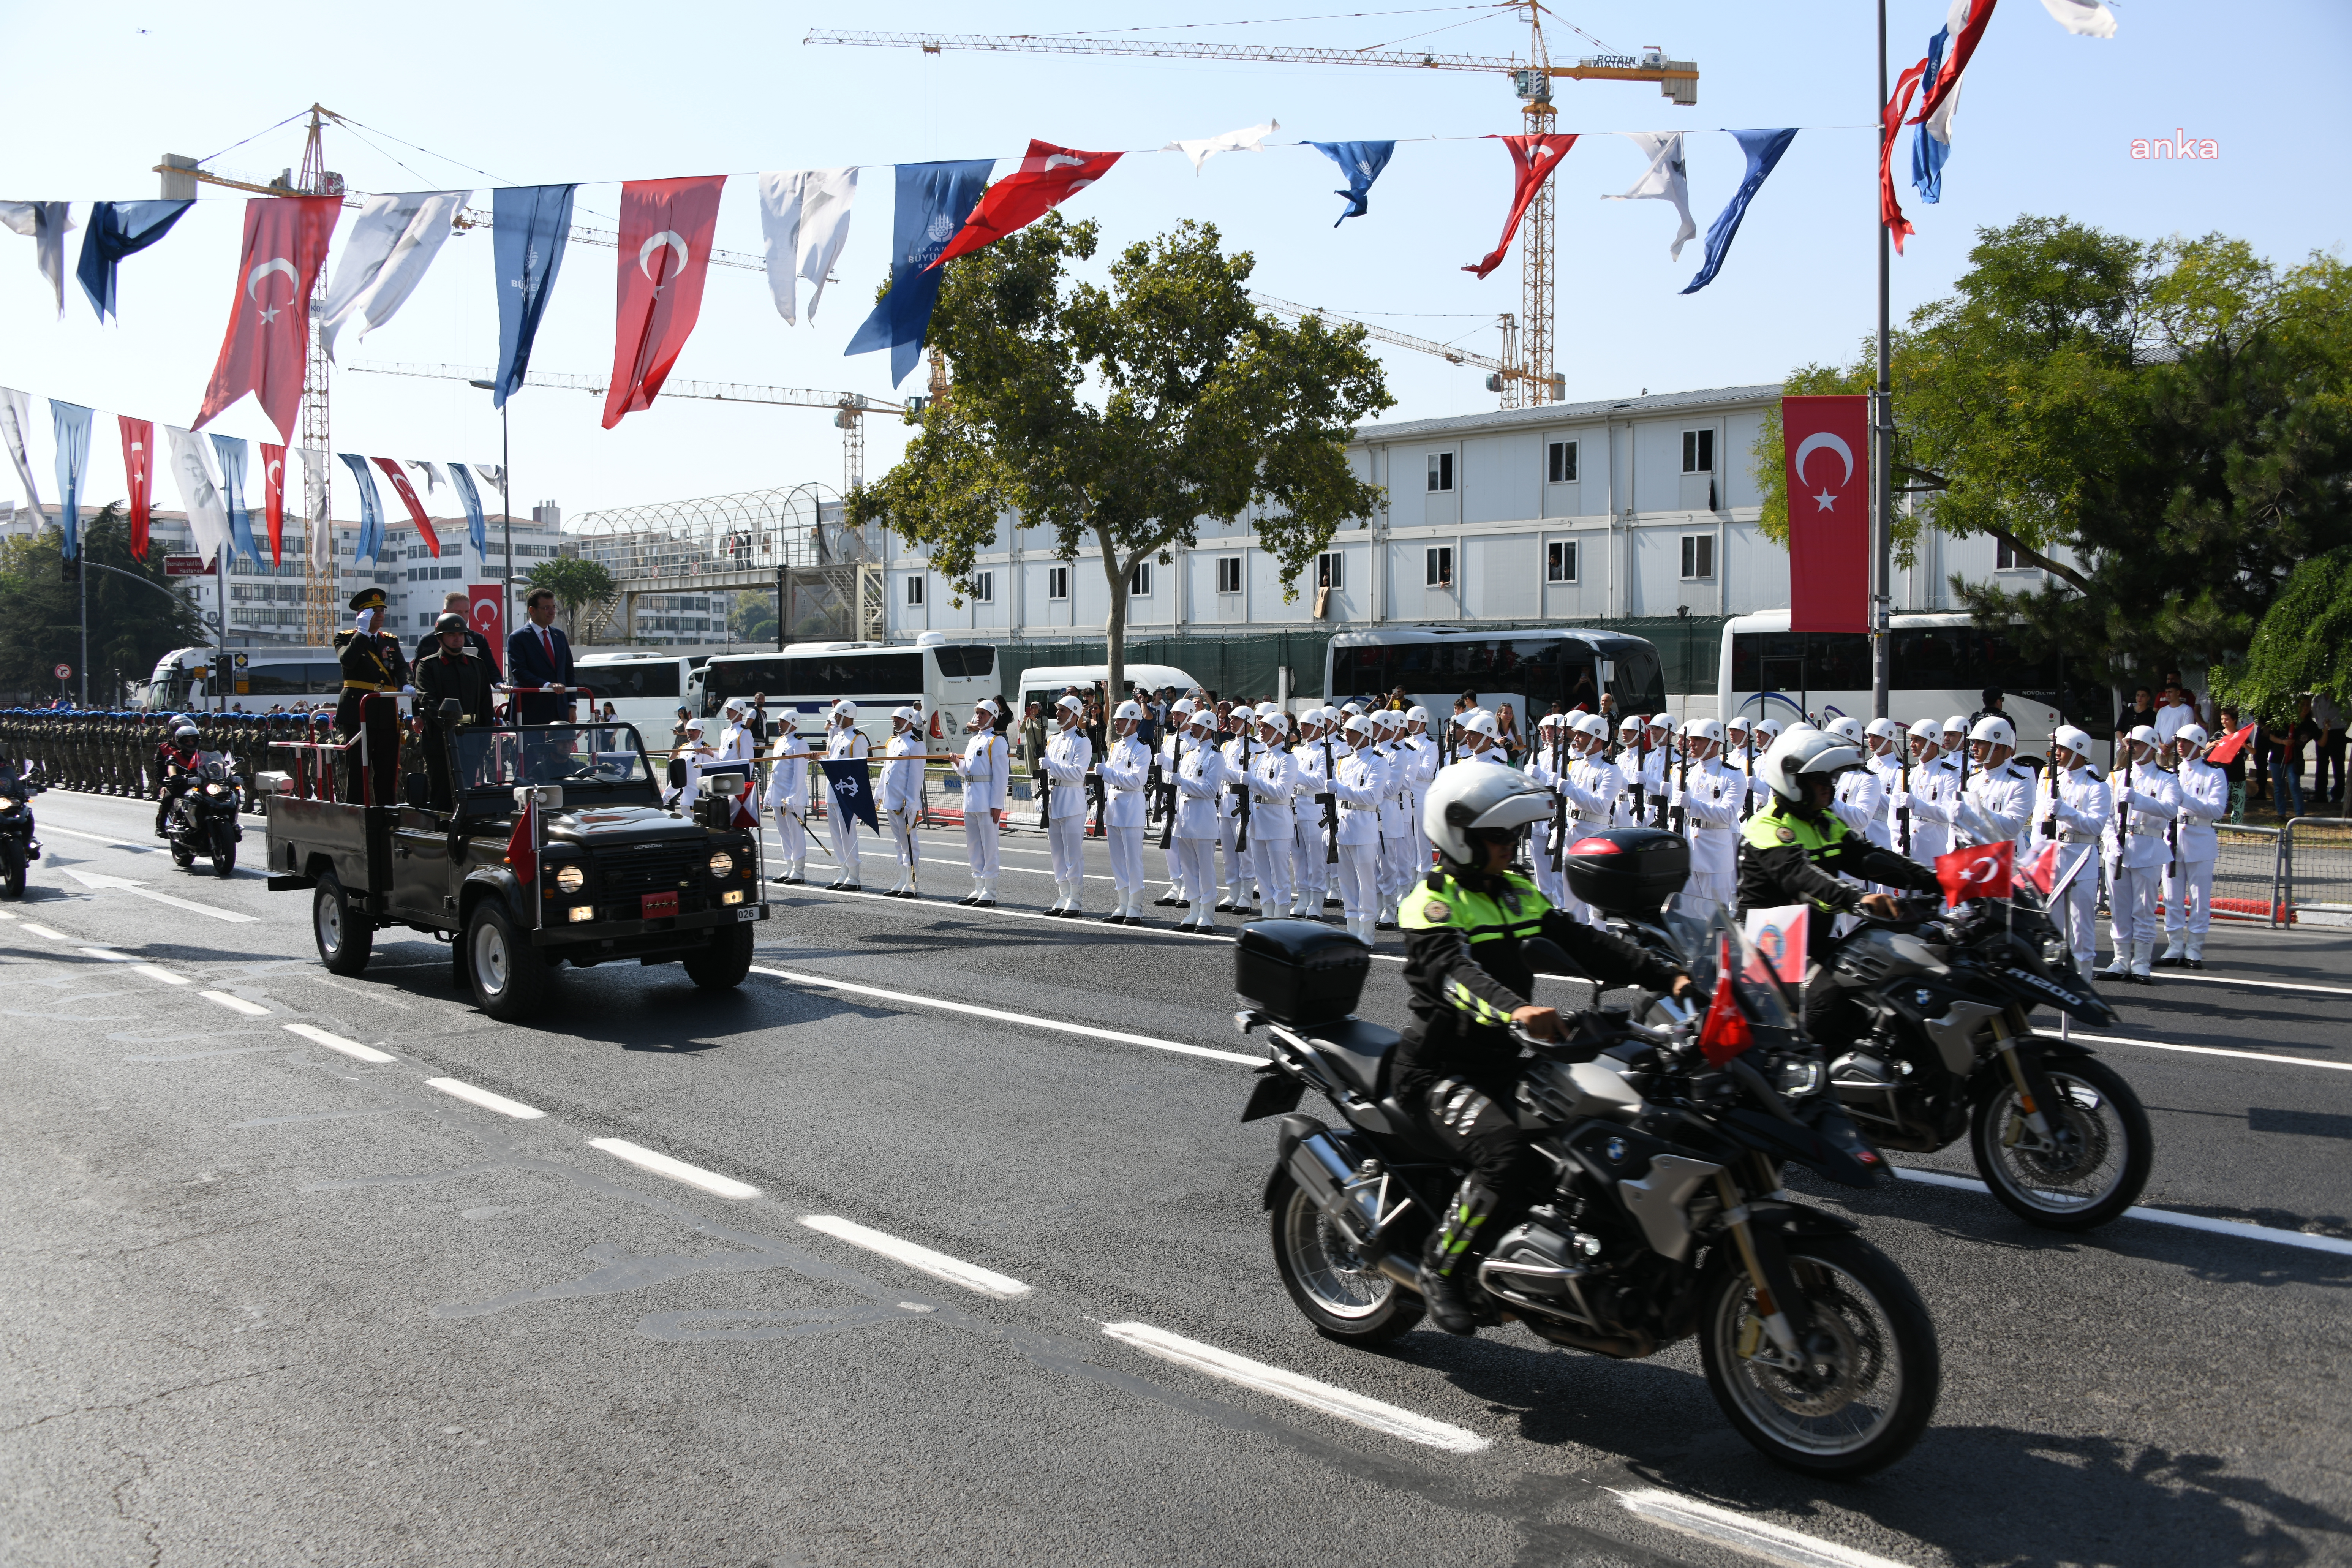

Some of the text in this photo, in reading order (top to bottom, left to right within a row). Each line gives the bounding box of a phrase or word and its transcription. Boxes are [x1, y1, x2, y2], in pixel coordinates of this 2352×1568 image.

[1597, 55, 1636, 64] POTAIN
[945, 779, 961, 788] POLİS
[1014, 785, 1031, 798] POLİS
[738, 909, 754, 919] 026
[2004, 967, 2083, 1005] R1200
